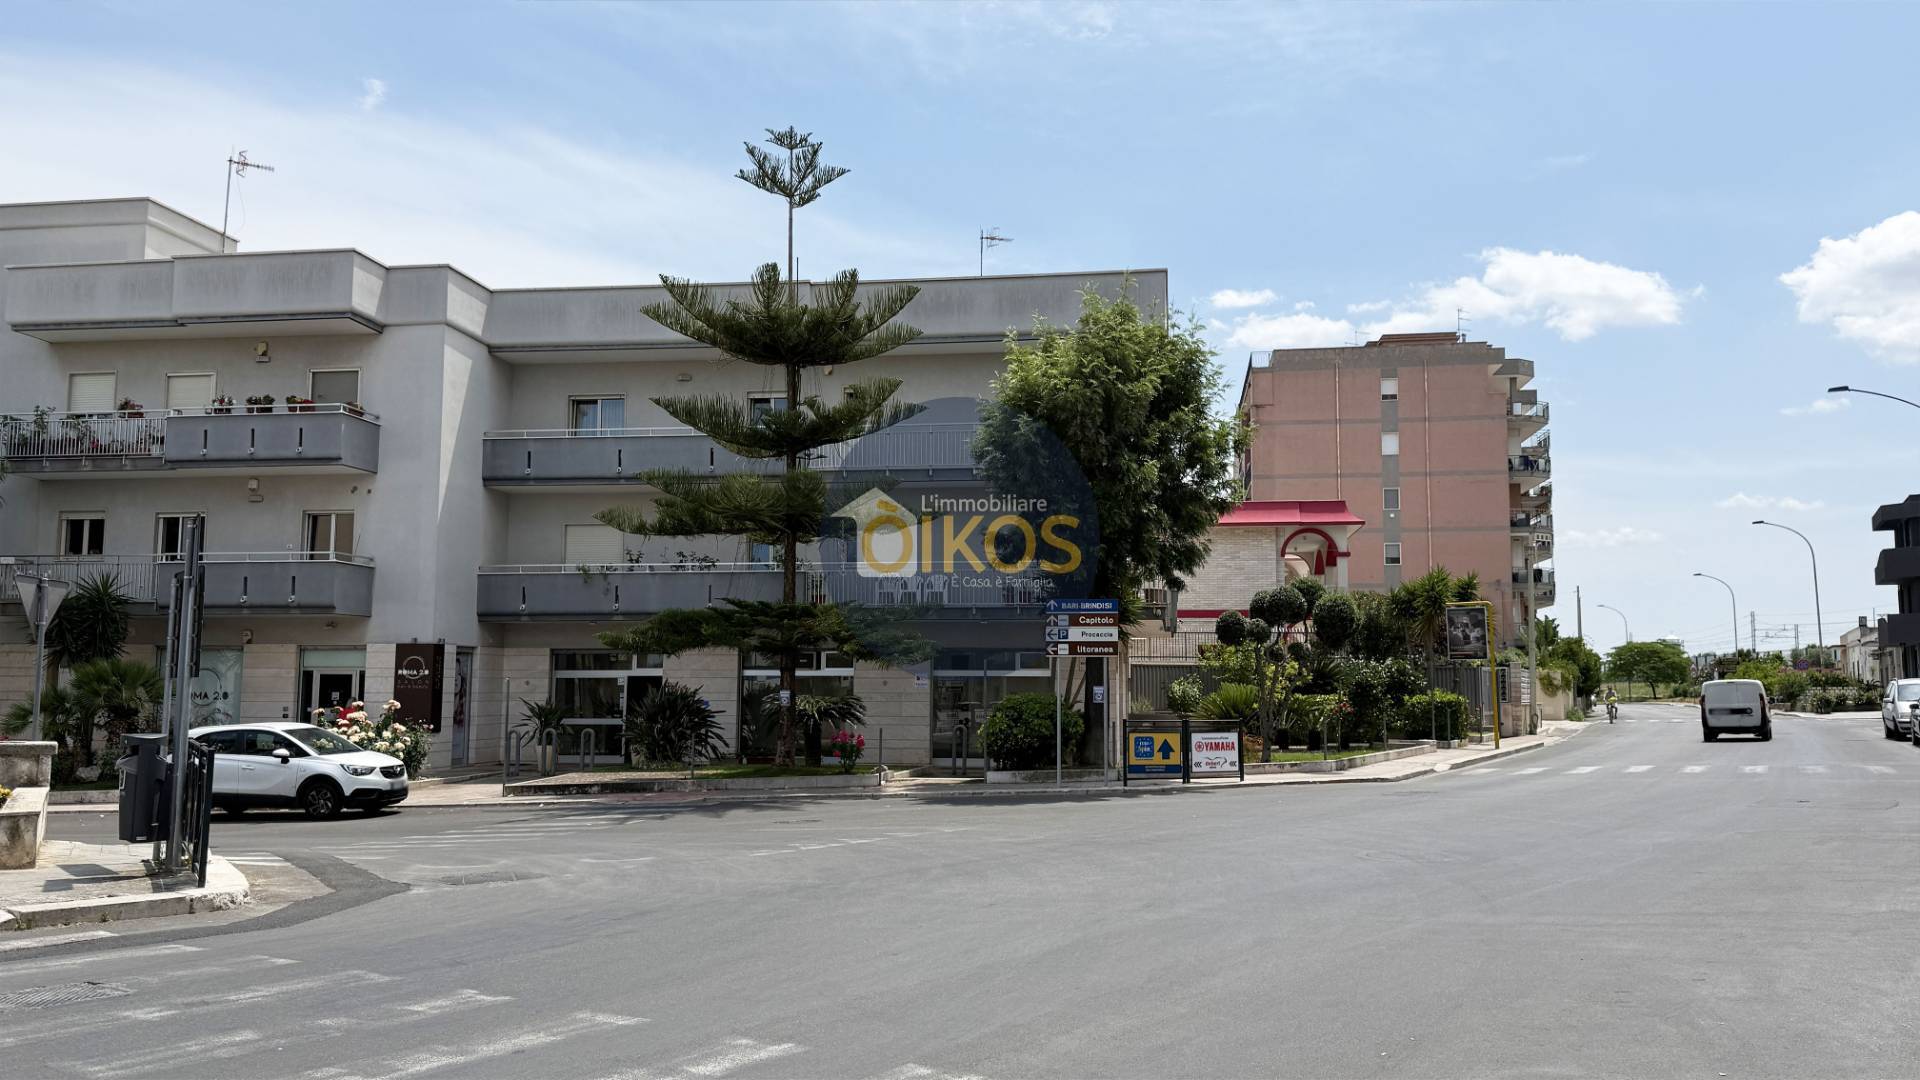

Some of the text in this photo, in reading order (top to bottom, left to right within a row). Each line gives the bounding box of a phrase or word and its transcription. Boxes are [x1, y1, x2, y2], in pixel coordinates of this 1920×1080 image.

[1078, 615, 1114, 625] Capitolo
[1081, 630, 1113, 638] Procaccia
[212, 691, 229, 701] 2.0
[1204, 741, 1236, 751] YAMAHA
